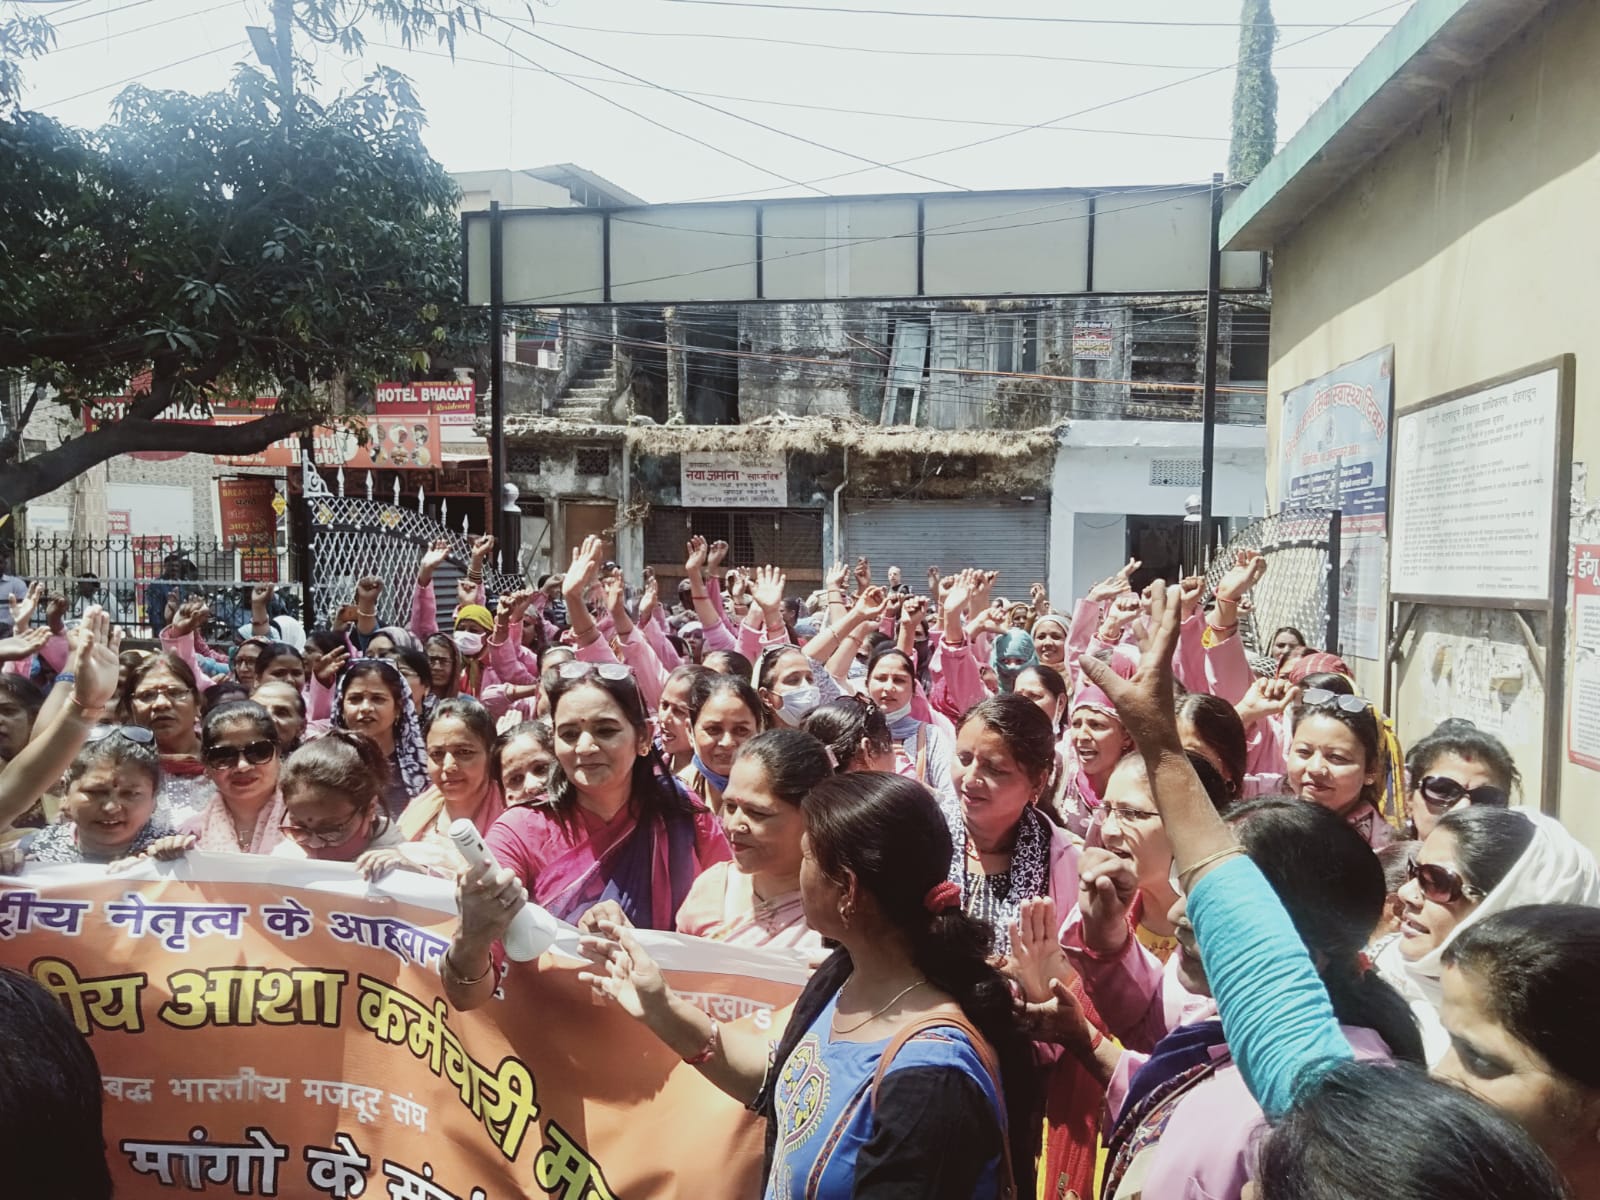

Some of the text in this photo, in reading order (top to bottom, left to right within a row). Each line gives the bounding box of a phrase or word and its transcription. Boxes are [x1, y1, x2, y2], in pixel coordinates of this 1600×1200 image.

[377, 387, 473, 402] HOTEL BHAGAT
[436, 402, 470, 411] Residency
[273, 433, 338, 449] unabi
[292, 448, 344, 465] Daba
[686, 470, 705, 481] नया
[222, 488, 247, 496] BREAK
[108, 893, 248, 951] नेतृत्व
[262, 897, 312, 938] के
[31, 957, 147, 1035] ीय
[158, 967, 348, 1029] आशा
[358, 974, 541, 1162] कर्मचारी
[168, 1067, 290, 1104] भारतीय
[301, 1078, 383, 1124] मजदूर
[389, 1092, 428, 1132] संघ
[120, 1126, 289, 1196] मांगो
[303, 1132, 371, 1199] के
